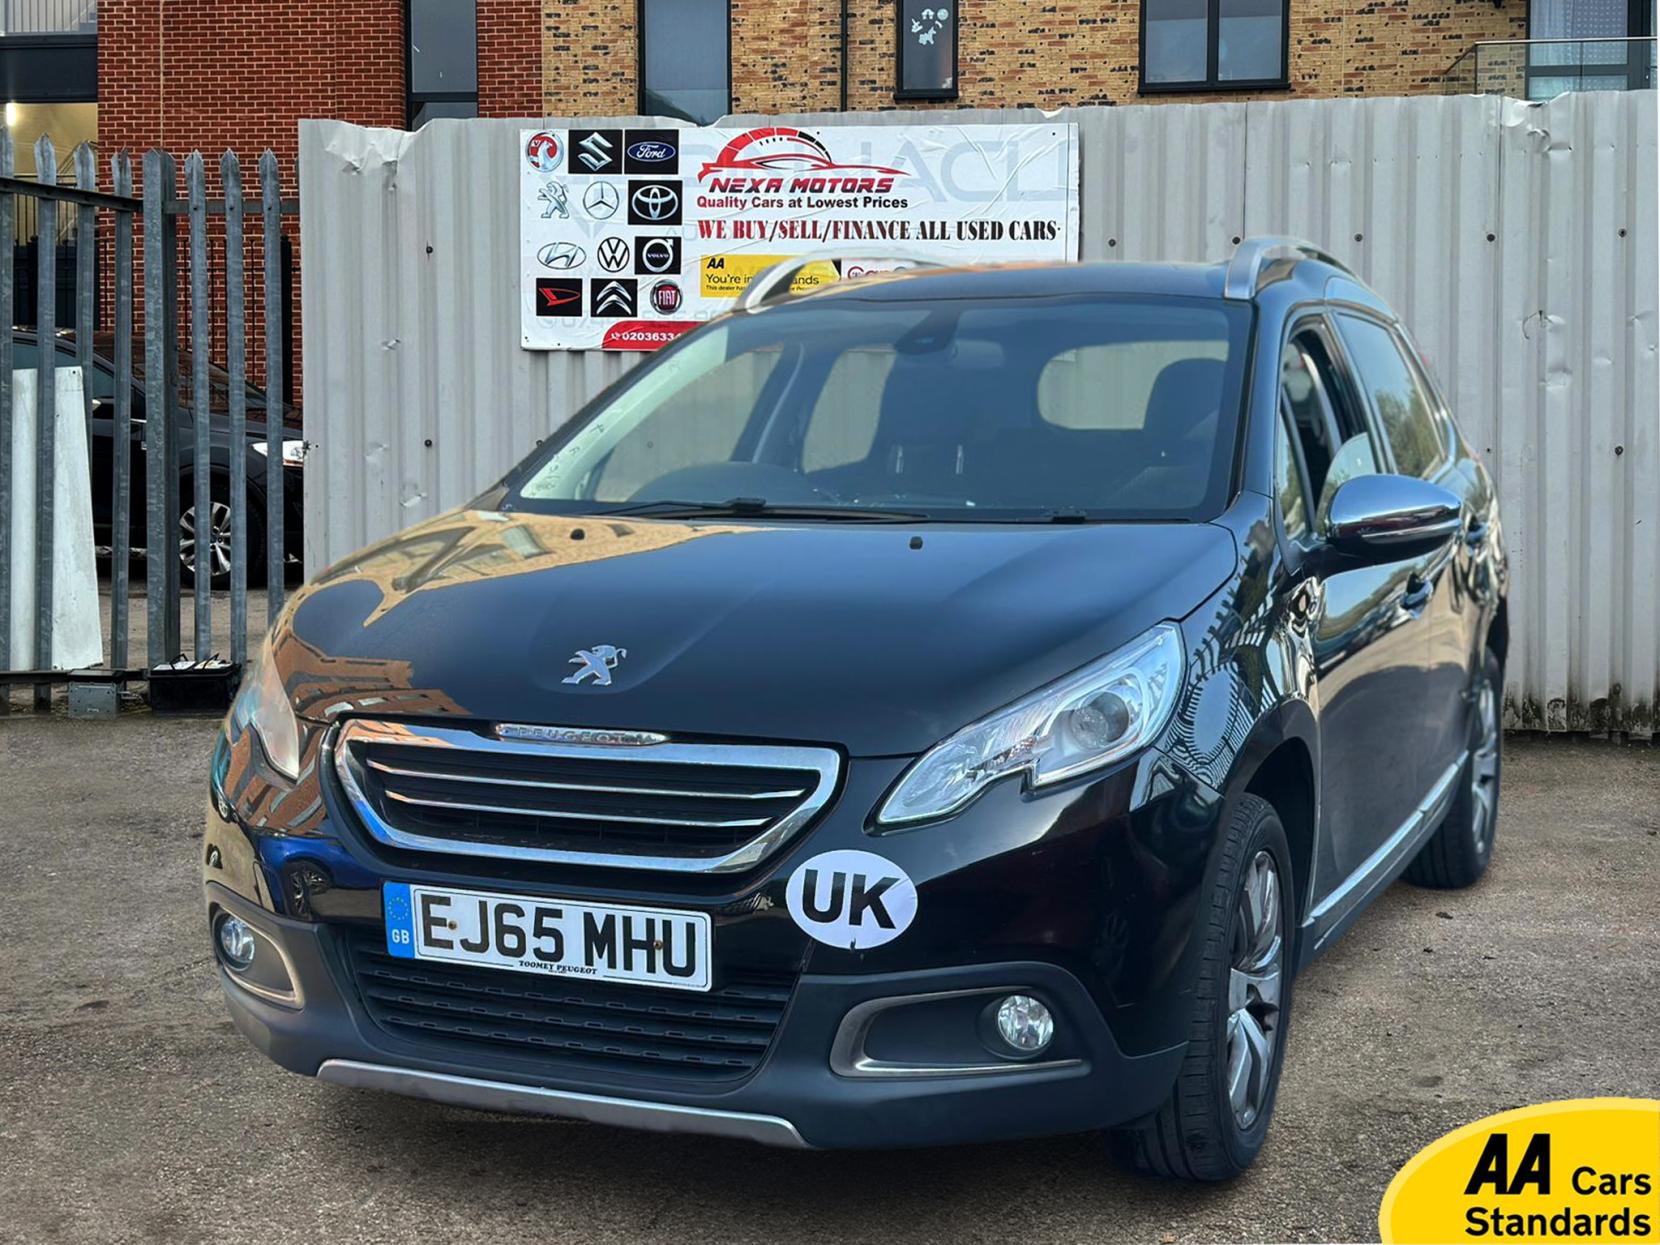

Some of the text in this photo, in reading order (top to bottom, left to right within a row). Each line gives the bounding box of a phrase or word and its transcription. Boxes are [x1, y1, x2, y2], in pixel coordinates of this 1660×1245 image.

[636, 143, 667, 159] Ford
[708, 177, 895, 194] NEXA MOTORS
[697, 195, 908, 210] Quality Cars at Lowest Prices
[697, 219, 727, 240] WE
[916, 220, 951, 240] ALL
[956, 220, 1004, 241] USED
[706, 257, 725, 269] AA
[705, 273, 741, 284] You're
[792, 275, 820, 285] ands
[658, 289, 676, 306] FIAT
[801, 868, 901, 930] UK
[391, 928, 410, 945] GB
[421, 893, 696, 978] EJ65 MHU
[518, 960, 598, 975] TOOMEY PEUGEOT
